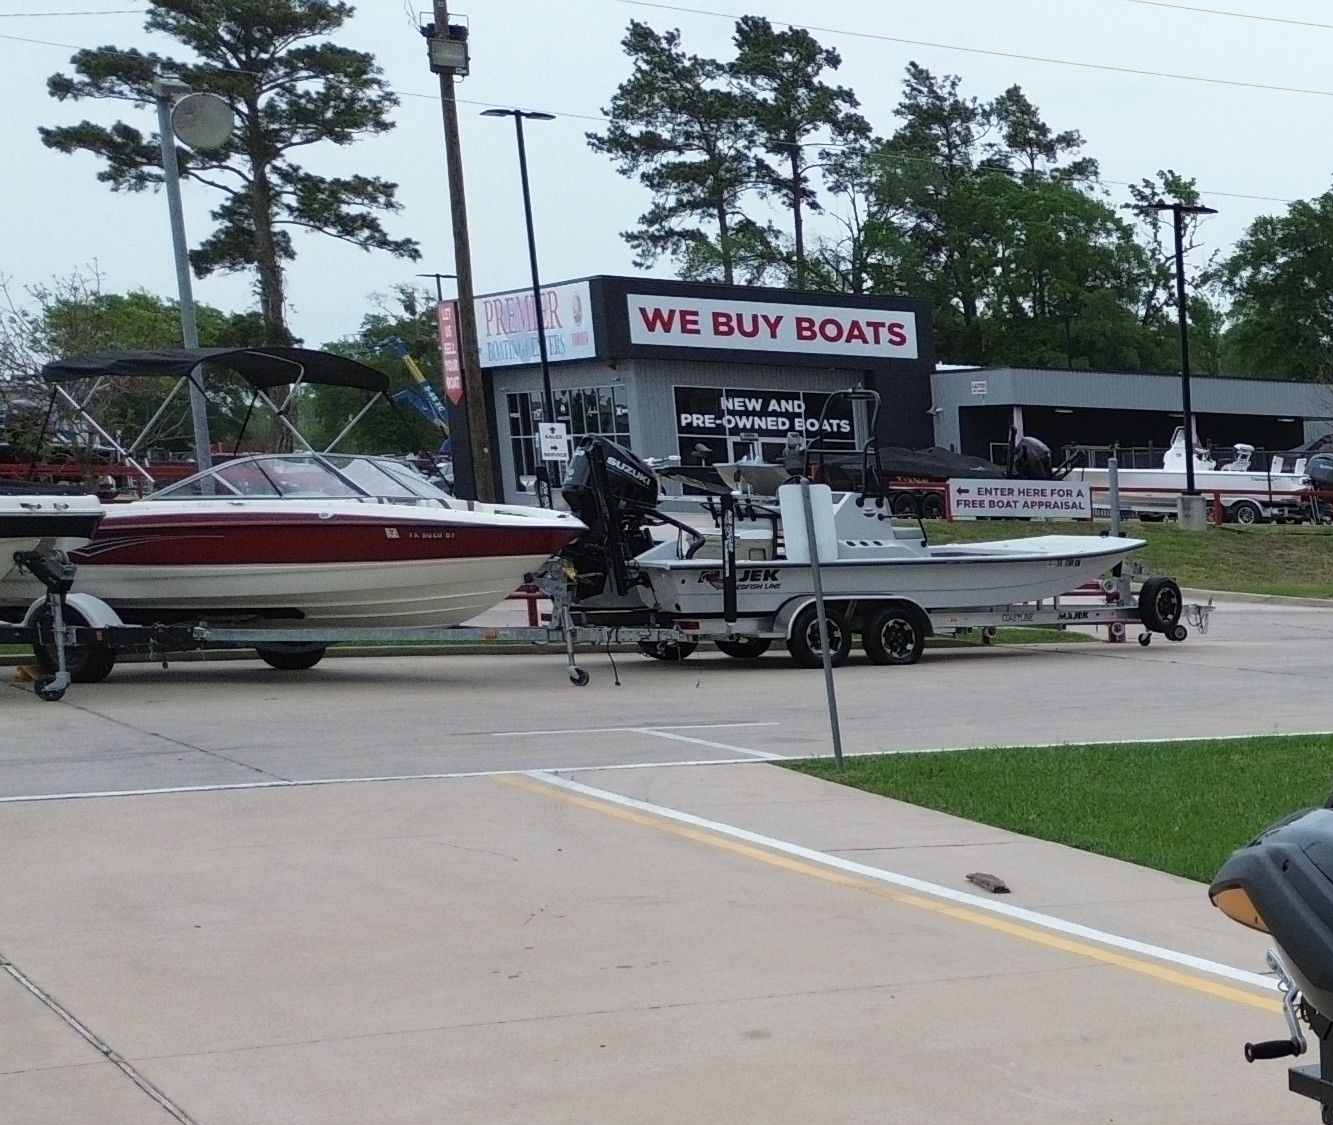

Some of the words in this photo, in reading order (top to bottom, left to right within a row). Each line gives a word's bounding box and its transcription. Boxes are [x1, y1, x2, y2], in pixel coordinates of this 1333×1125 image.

[638, 307, 701, 335] WE
[712, 311, 783, 339] BUY
[795, 317, 907, 346] BOATS
[720, 396, 763, 411] NEW
[768, 399, 806, 413] AND
[680, 413, 790, 430] PRE-OWNED
[794, 418, 851, 433] BOATS
[606, 456, 651, 486] SUZUKI
[977, 487, 1015, 497] ENTER
[1018, 488, 1048, 498] HERE
[1051, 488, 1074, 498] FOR
[1076, 489, 1085, 498] A
[956, 499, 985, 508] FREE
[988, 499, 1018, 509] BOAT
[1022, 500, 1085, 510] APPRAISAL
